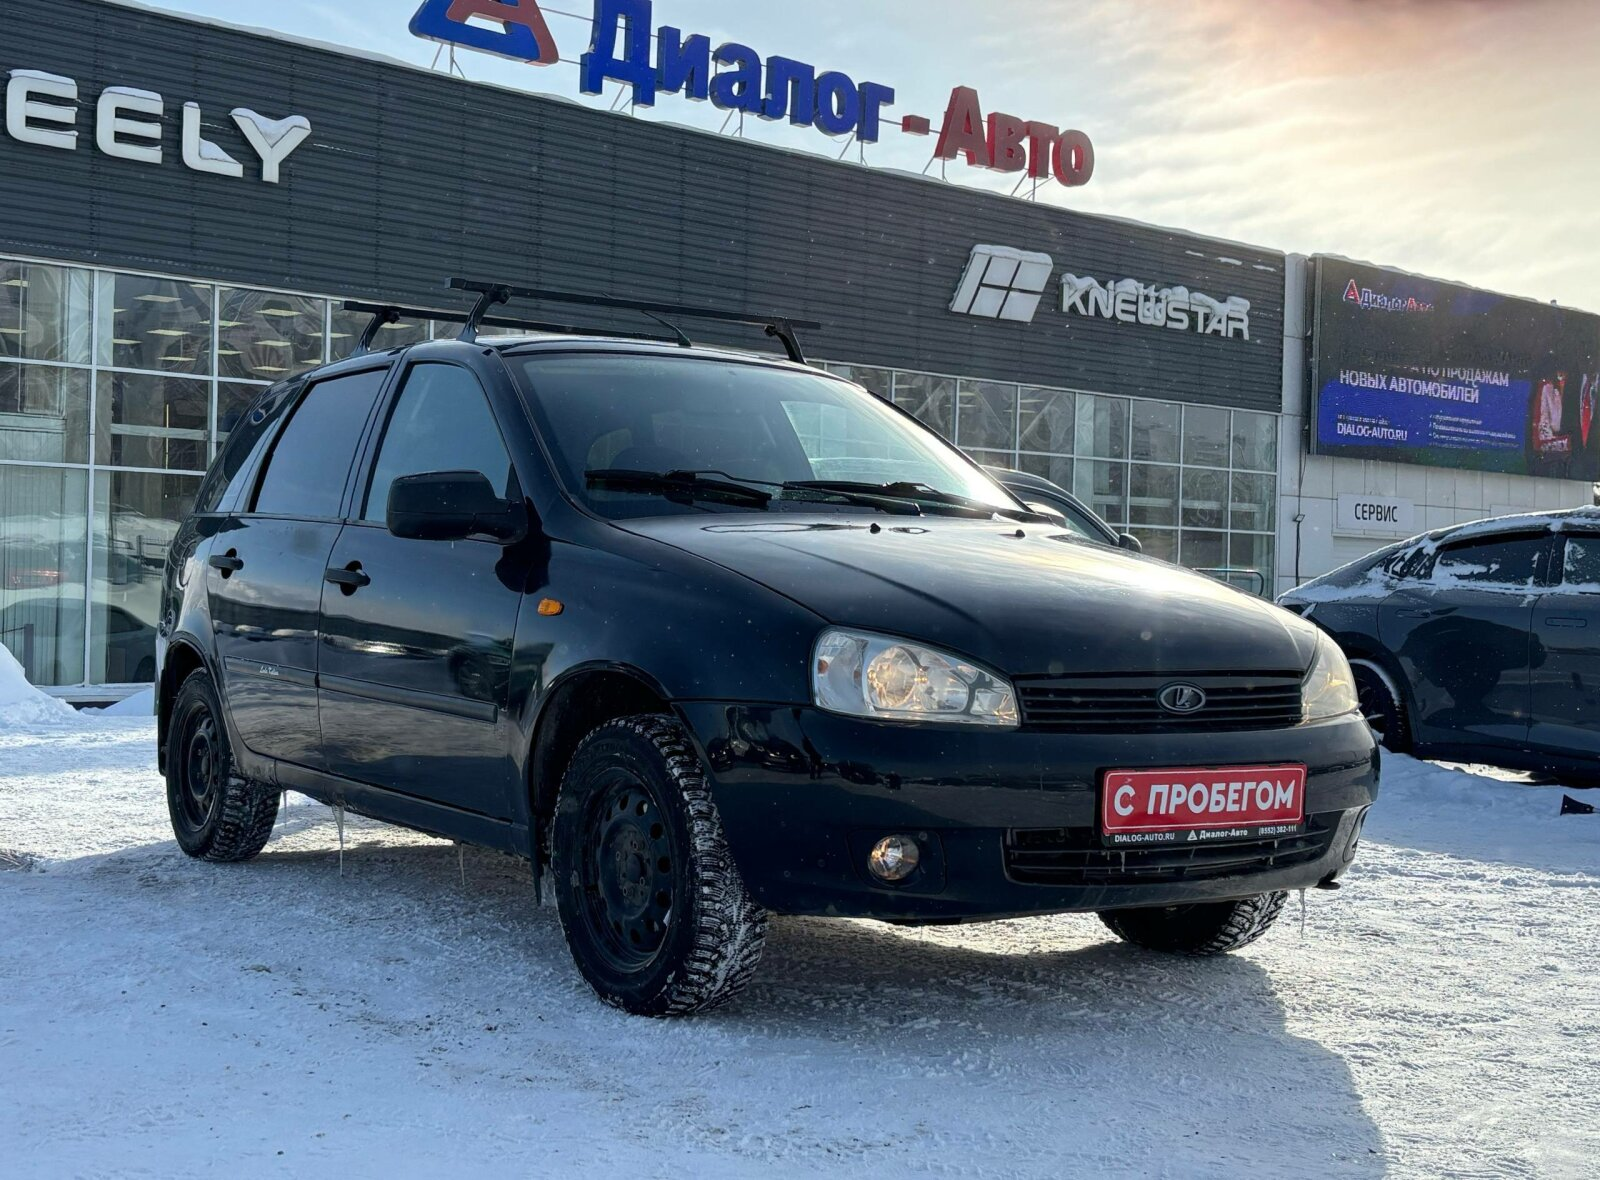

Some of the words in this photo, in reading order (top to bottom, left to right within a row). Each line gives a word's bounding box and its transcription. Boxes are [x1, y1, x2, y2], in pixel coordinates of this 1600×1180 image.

[580, 0, 1095, 187] Диалог-Авто
[5, 69, 312, 184] EELY
[1339, 369, 1387, 390] НОВЫХ
[1389, 376, 1479, 404] АВТОМОБИЛЕЙ
[1442, 367, 1509, 387] ПРОДАЖАМ
[1337, 422, 1408, 441] DIALOG-AUTO.RU
[1354, 502, 1398, 523] СЕРВИС
[1114, 784, 1136, 816] С
[1147, 780, 1296, 815] ПРОБЕГОМ
[1114, 832, 1175, 843] DIALOG-AUTO.RU
[1199, 828, 1248, 840] Диалог-Авто
